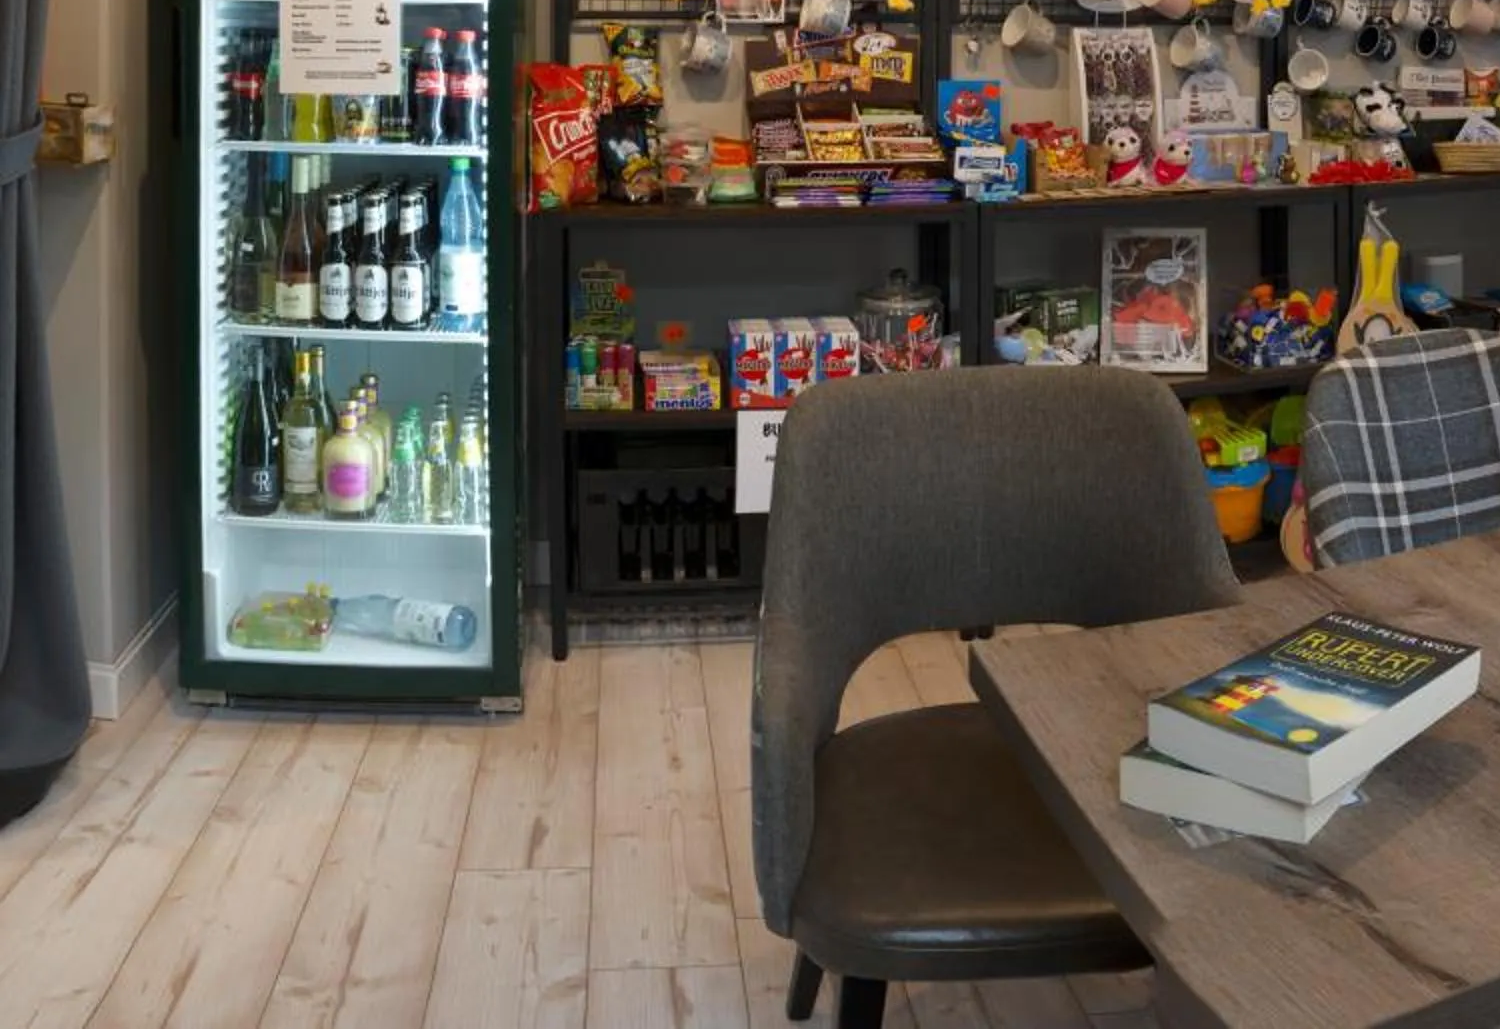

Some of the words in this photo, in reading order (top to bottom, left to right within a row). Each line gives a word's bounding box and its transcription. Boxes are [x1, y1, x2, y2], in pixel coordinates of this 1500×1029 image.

[655, 395, 713, 408] mentos
[1299, 630, 1436, 672] RUPERT
[1422, 640, 1468, 655] WOLF
[1286, 646, 1406, 681] UNDERCOVER
